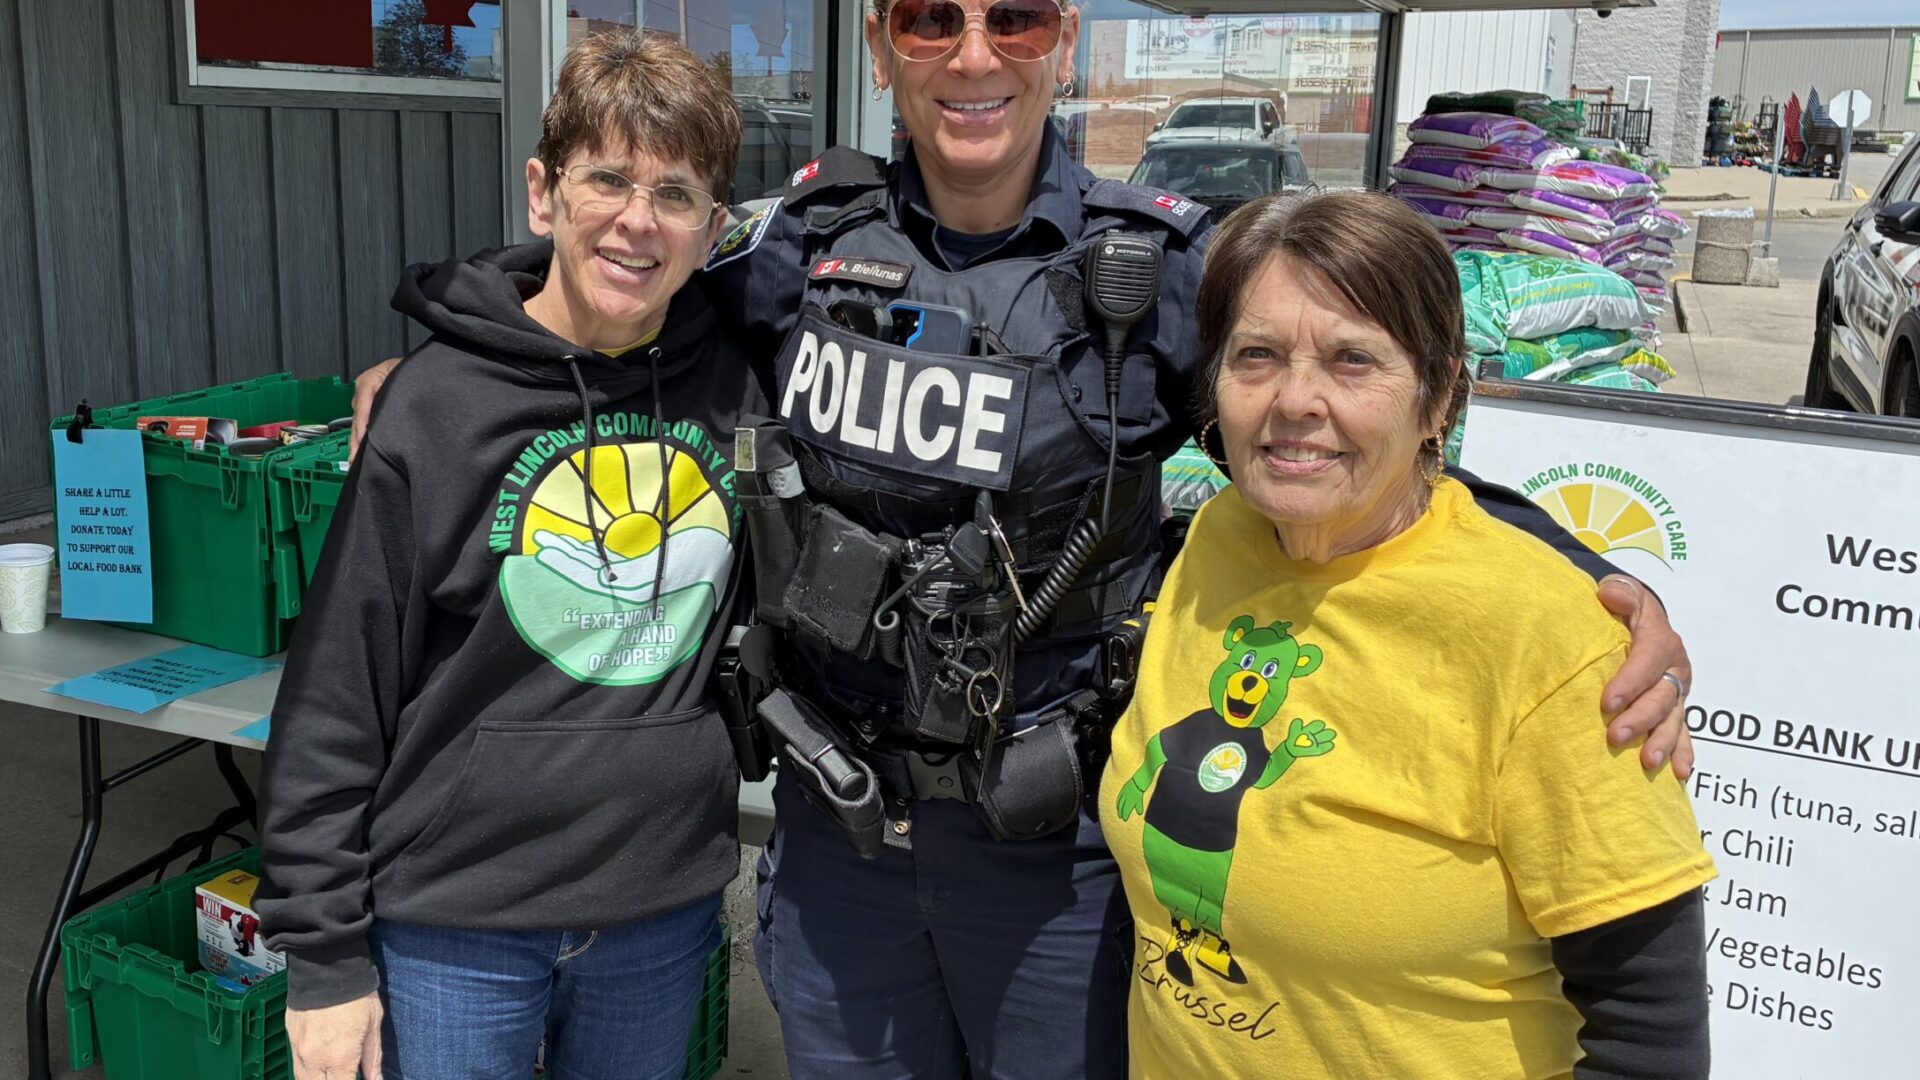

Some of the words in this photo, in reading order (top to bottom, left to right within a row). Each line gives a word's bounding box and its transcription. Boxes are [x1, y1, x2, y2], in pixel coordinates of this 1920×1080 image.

[836, 262, 848, 272] A.
[1116, 249, 1151, 257] MOTOROLA
[780, 330, 1013, 473] POLICE
[64, 487, 94, 497] SHARE
[96, 488, 103, 497] A
[104, 488, 132, 498] LITTLE
[488, 488, 520, 553] WEST
[504, 419, 588, 488] LINCOLN
[79, 506, 100, 516] HELP
[102, 507, 110, 516] A
[111, 507, 128, 517] LOT.
[1517, 462, 1579, 498] INCOLN
[1584, 462, 1677, 518] COMMUNITY
[1665, 519, 1688, 562] CARE
[71, 524, 105, 535] DONATE
[106, 525, 135, 536] TODAY
[66, 542, 78, 553] TO
[79, 543, 117, 554] SUPPORT
[118, 545, 135, 555] OUR
[1826, 533, 1918, 575] Wes
[67, 561, 95, 572] LOCAL
[96, 563, 117, 573] FOOD
[119, 564, 144, 574] BANK
[1775, 583, 1920, 631] Comm
[617, 631, 628, 647] A
[630, 624, 676, 645] HAND
[588, 653, 610, 672] OF
[1684, 705, 1761, 741] OOD
[1773, 719, 1874, 762] BANK
[1770, 785, 1862, 834] (tuna,
[1873, 810, 1920, 840] sal
[1722, 828, 1794, 867] Chili
[202, 897, 222, 919] WIN
[1720, 879, 1787, 917] Jam
[1726, 981, 1834, 1031] Dishes
